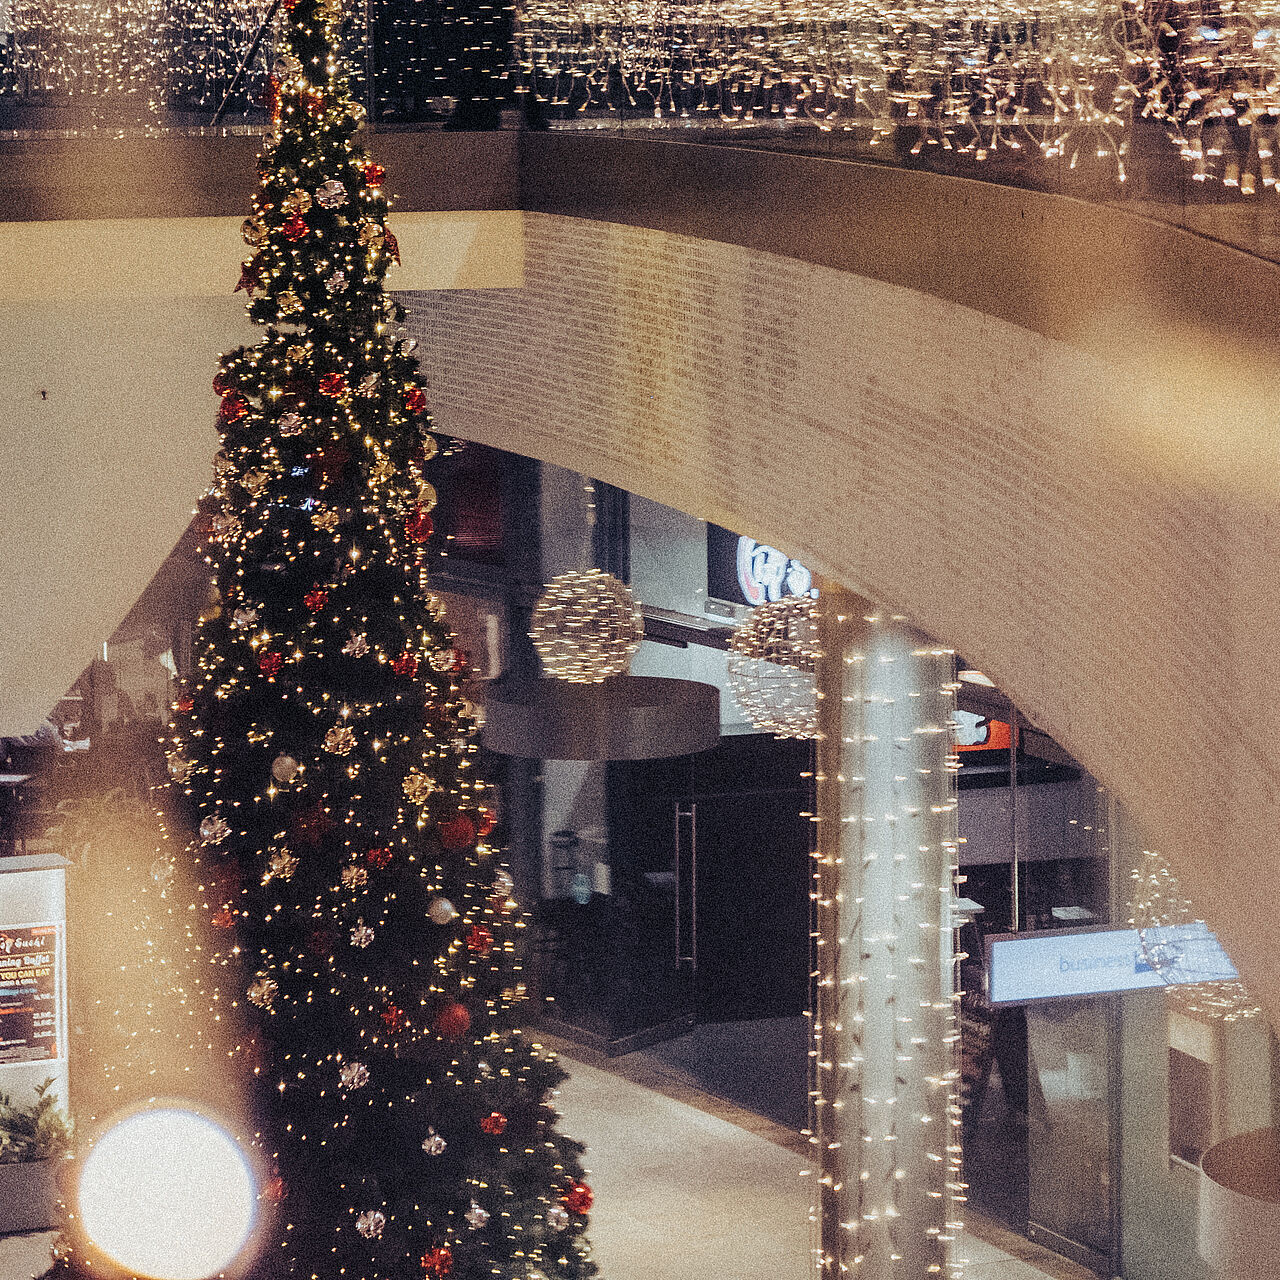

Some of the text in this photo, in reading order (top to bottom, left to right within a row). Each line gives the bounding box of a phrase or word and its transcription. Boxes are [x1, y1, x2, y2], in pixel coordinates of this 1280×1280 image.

[0, 971, 18, 980] YOU
[18, 969, 35, 979] CAN
[35, 967, 51, 977] EAT
